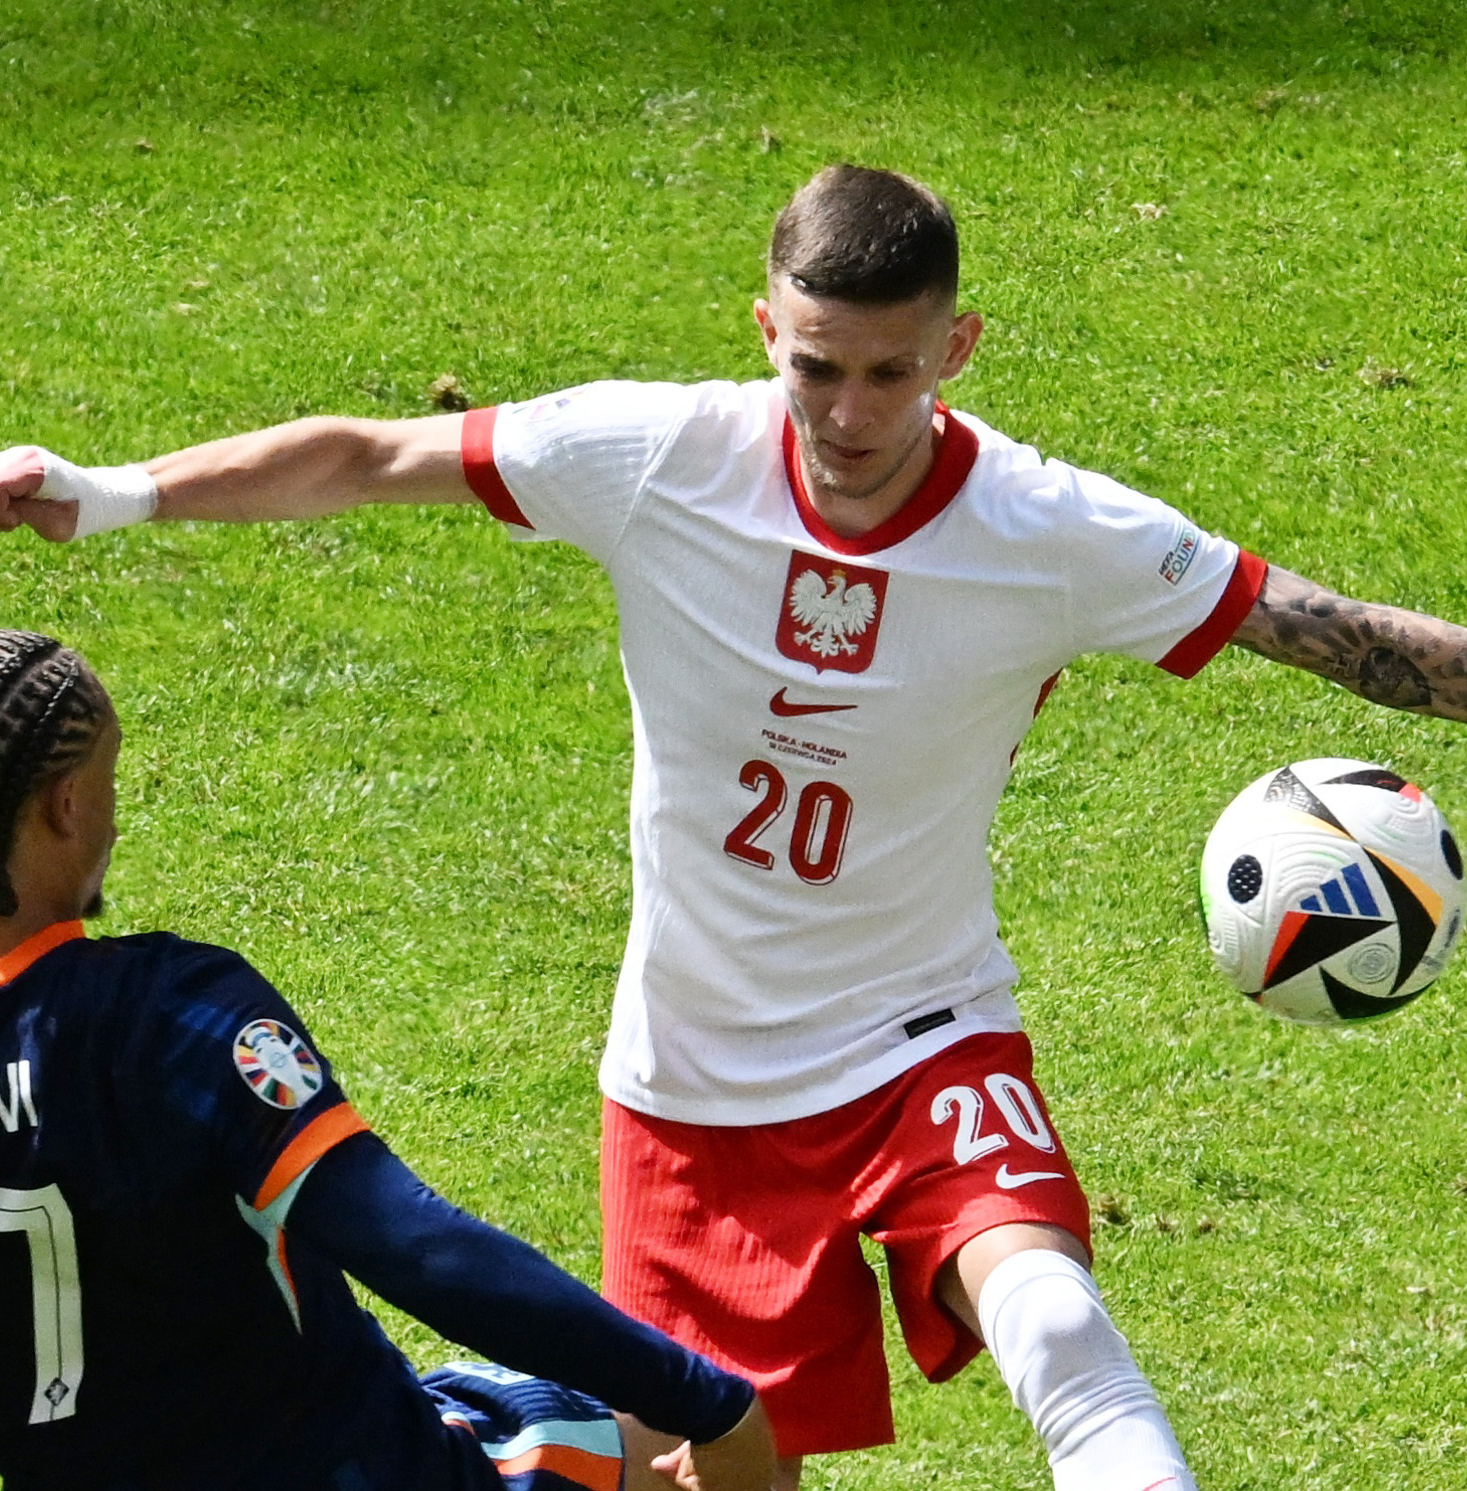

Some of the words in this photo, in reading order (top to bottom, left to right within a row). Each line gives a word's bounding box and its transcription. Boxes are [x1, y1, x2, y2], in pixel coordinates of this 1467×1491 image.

[762, 729, 796, 745] POLSKA
[802, 741, 847, 759] HOLANDIA
[723, 760, 853, 885] 20
[930, 1073, 1056, 1166] 20
